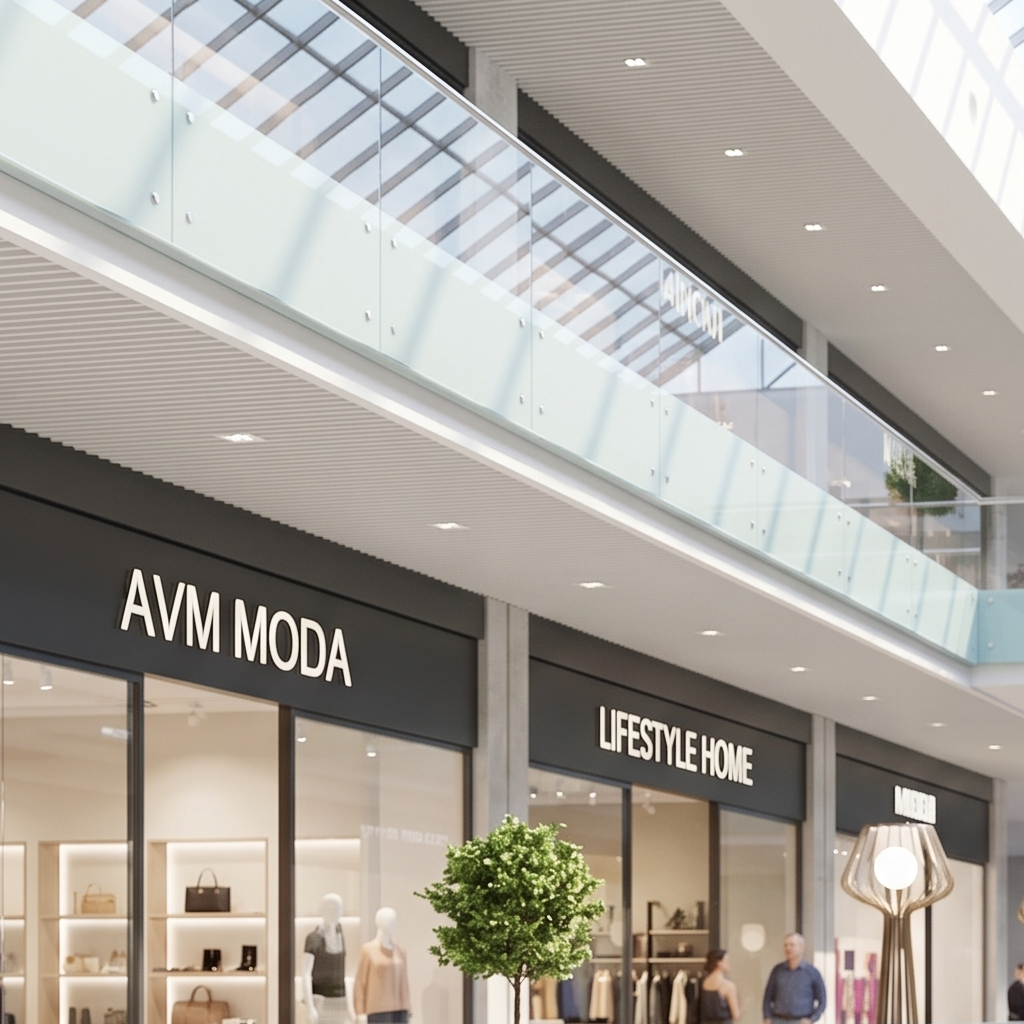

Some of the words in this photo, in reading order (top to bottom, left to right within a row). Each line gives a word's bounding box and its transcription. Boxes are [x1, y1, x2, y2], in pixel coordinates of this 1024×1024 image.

[120, 568, 220, 653] AVM
[234, 598, 352, 687] MODA
[600, 706, 698, 772] LIFESTYLE
[701, 735, 754, 786] HOME
